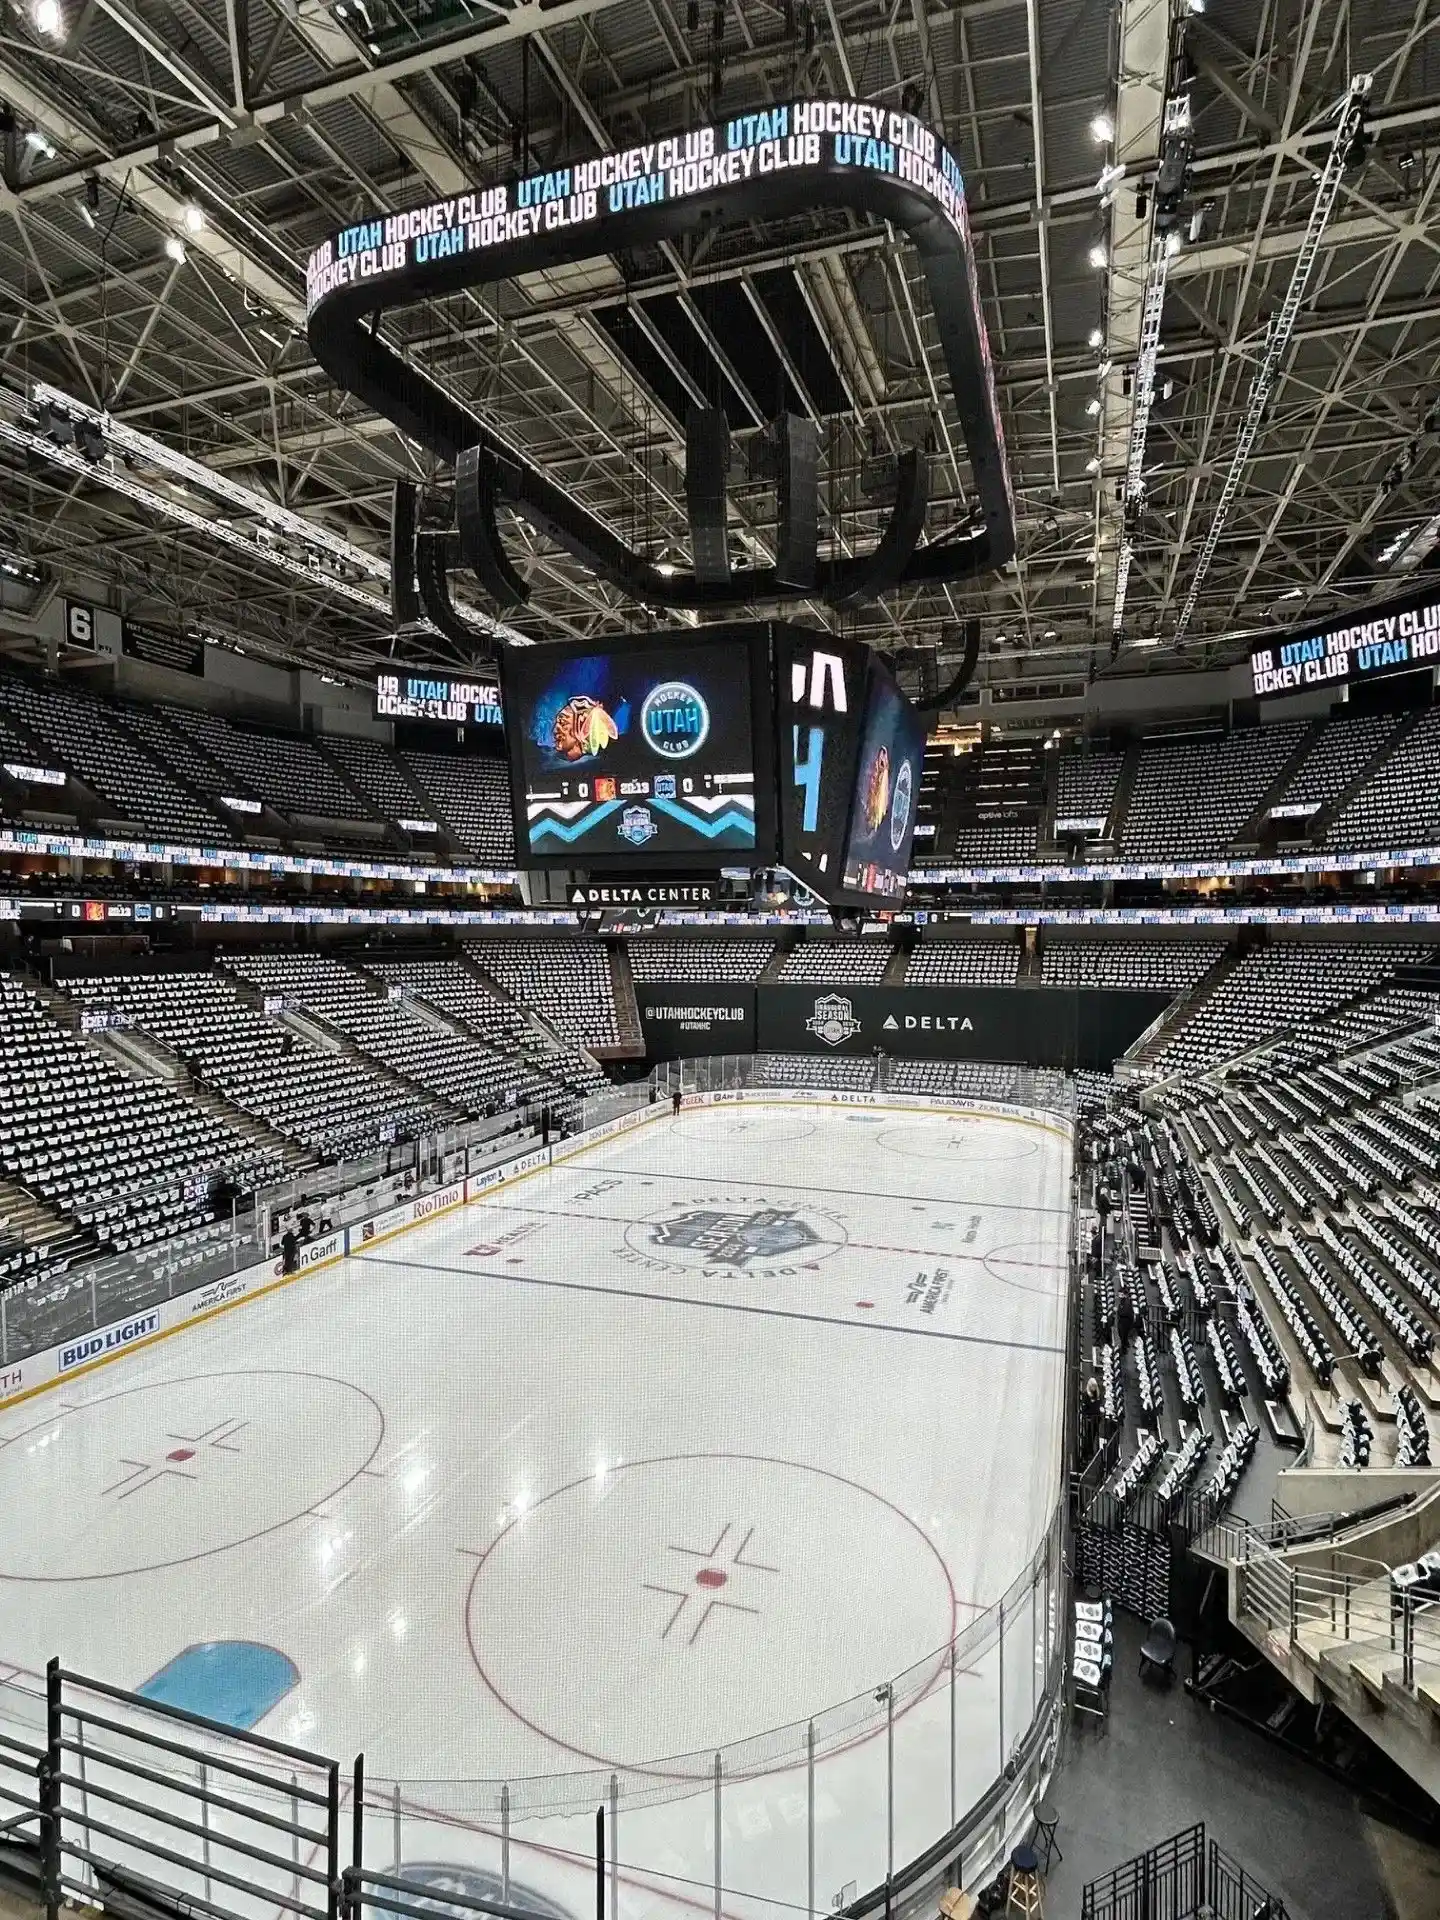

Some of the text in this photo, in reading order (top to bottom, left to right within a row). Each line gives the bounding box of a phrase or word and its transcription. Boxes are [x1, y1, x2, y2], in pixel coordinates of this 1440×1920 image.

[338, 220, 382, 258] UTAH
[385, 200, 456, 244] HOCKEY
[458, 186, 507, 224] CLUB
[517, 168, 570, 208] UTAH
[574, 144, 655, 193] HOCKEY
[657, 127, 715, 170] CLUB
[727, 105, 788, 150] UTAH
[793, 101, 886, 138] HOCKEY
[888, 113, 936, 164] CLUB
[360, 242, 406, 277] CLUB
[415, 226, 464, 264] UTAH
[468, 205, 542, 250] HOCKEY
[545, 190, 597, 230] CLUB
[608, 172, 664, 213] UTAH
[669, 146, 755, 197] HOCKEY
[758, 134, 820, 173] CLUB
[835, 134, 895, 173] UTAH
[70, 606, 91, 641] 6
[1281, 637, 1324, 666] UTAH
[1326, 616, 1396, 655] HOCKEY
[1305, 652, 1349, 682] CLUB
[1358, 638, 1408, 670] UTAH
[1411, 629, 1440, 658] HO
[407, 679, 448, 700] UTAH
[654, 691, 693, 707] HOCKEY
[650, 708, 698, 735] UTAH
[663, 740, 689, 751] CLUB
[589, 887, 711, 902] DELTA CENTER
[645, 1007, 745, 1021] @UTAHHOCKEYCLUB
[817, 1010, 849, 1021] SEASON
[904, 1015, 974, 1031] DELTA
[841, 1094, 876, 1104] DELTA
[521, 1153, 547, 1170] DELTA
[63, 1314, 157, 1367] BUD LIGHT
